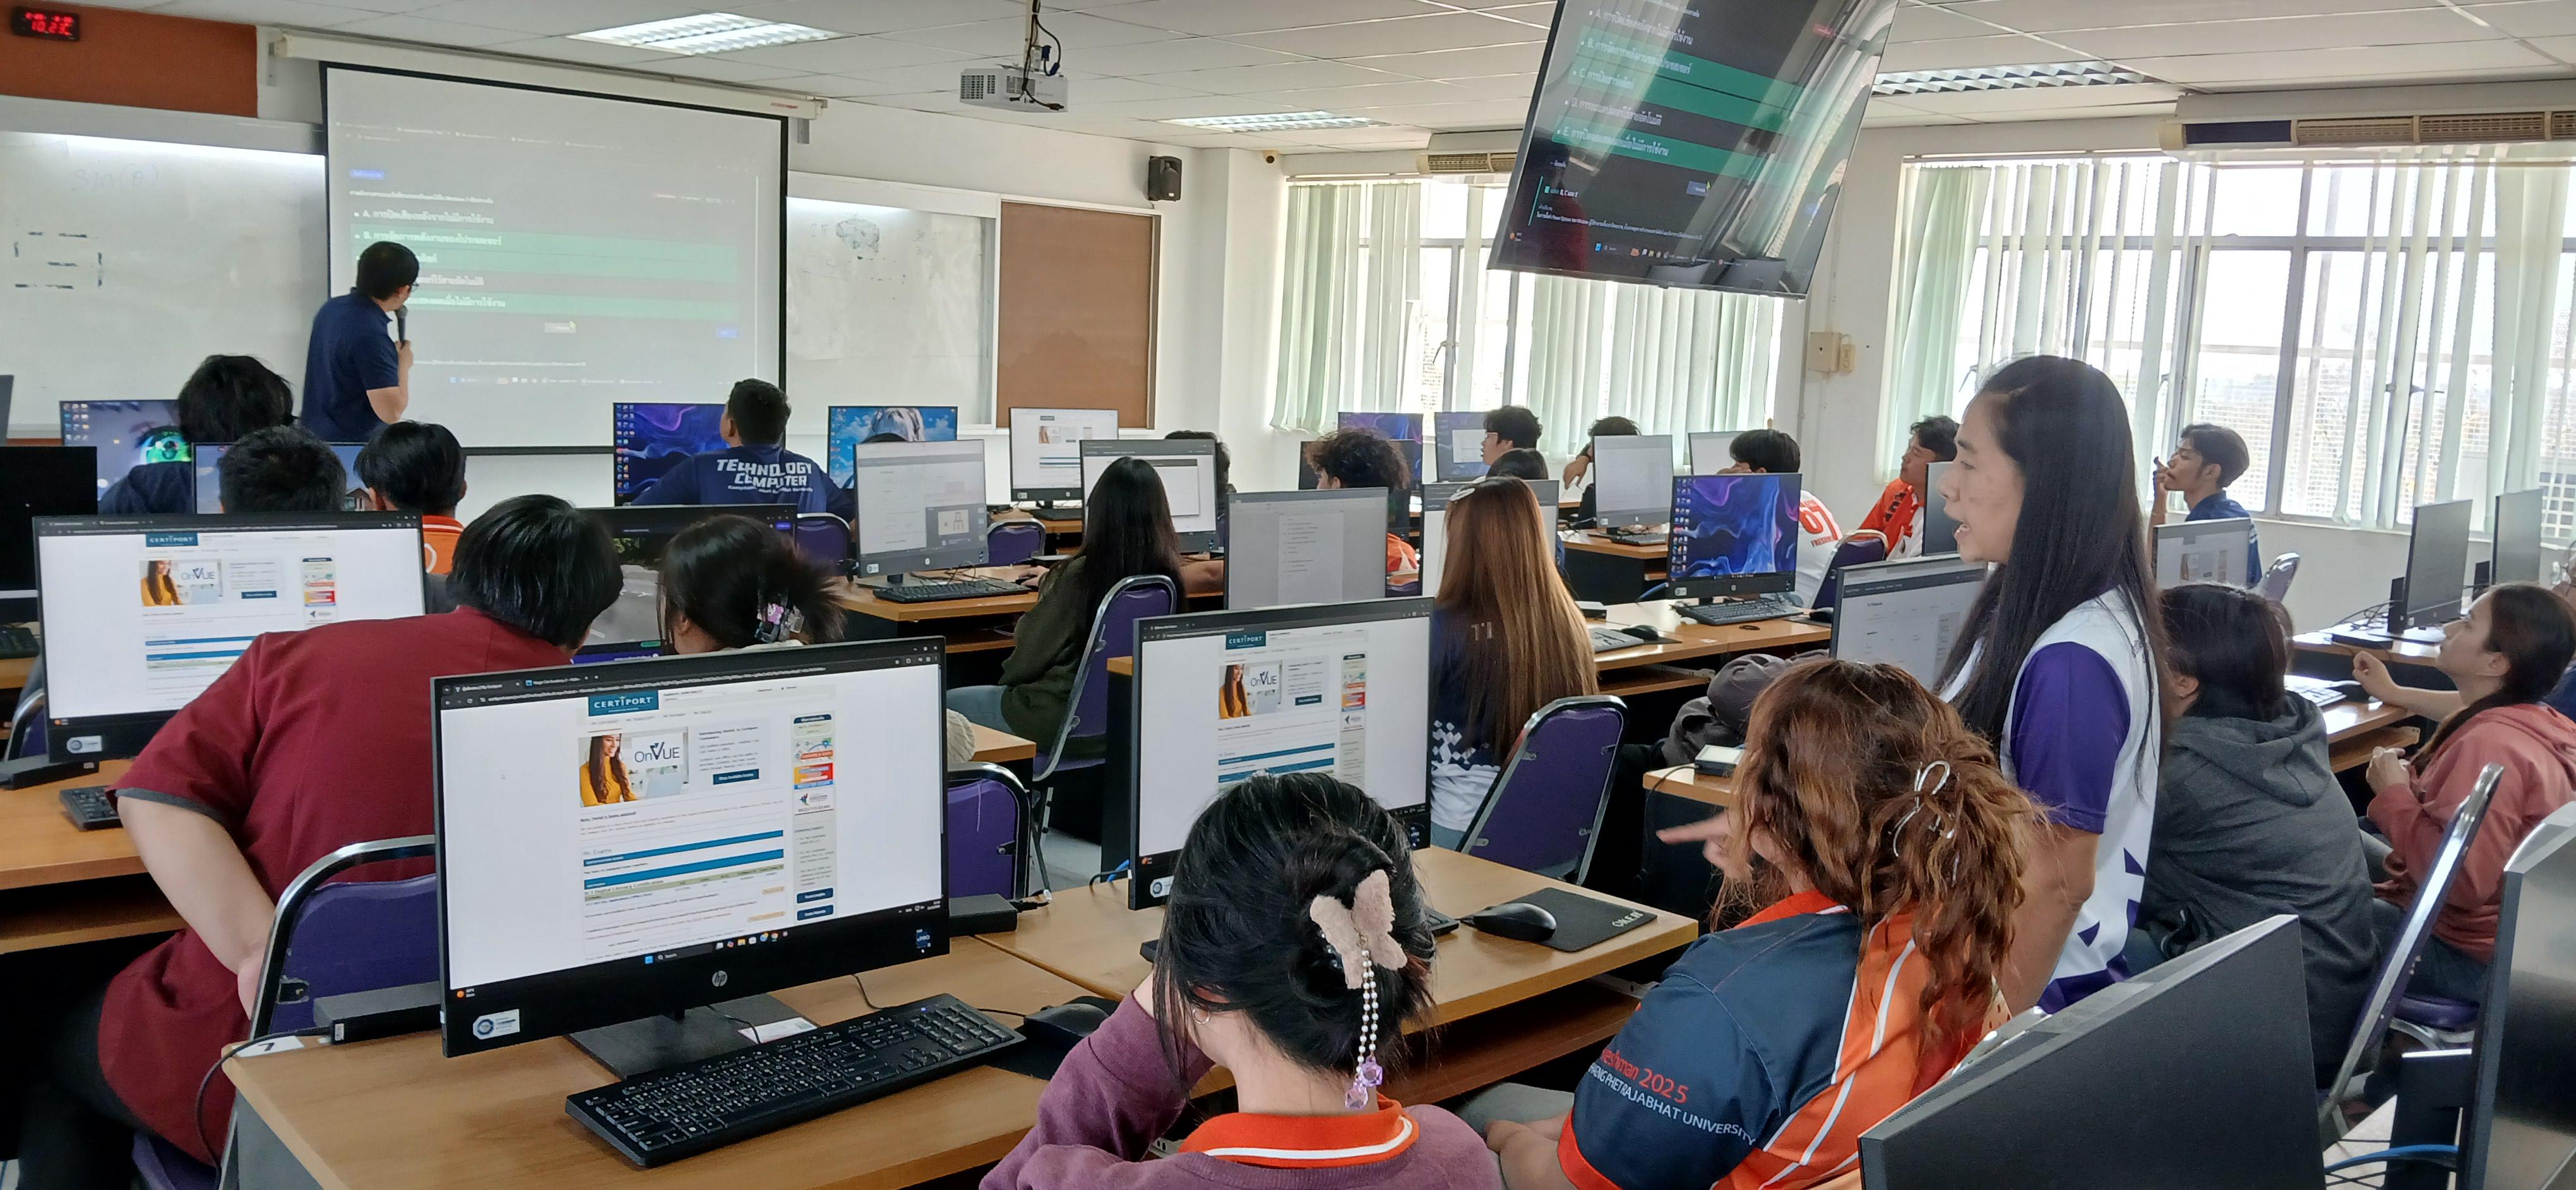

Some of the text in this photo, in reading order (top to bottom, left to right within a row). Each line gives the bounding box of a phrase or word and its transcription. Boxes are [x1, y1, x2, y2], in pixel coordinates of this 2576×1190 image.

[593, 695, 652, 709] CERTIPORT
[634, 740, 680, 764] OnVUE
[1601, 1048, 1690, 1104] eshman 2025
[1682, 1114, 1756, 1146] UNIVERSITY
